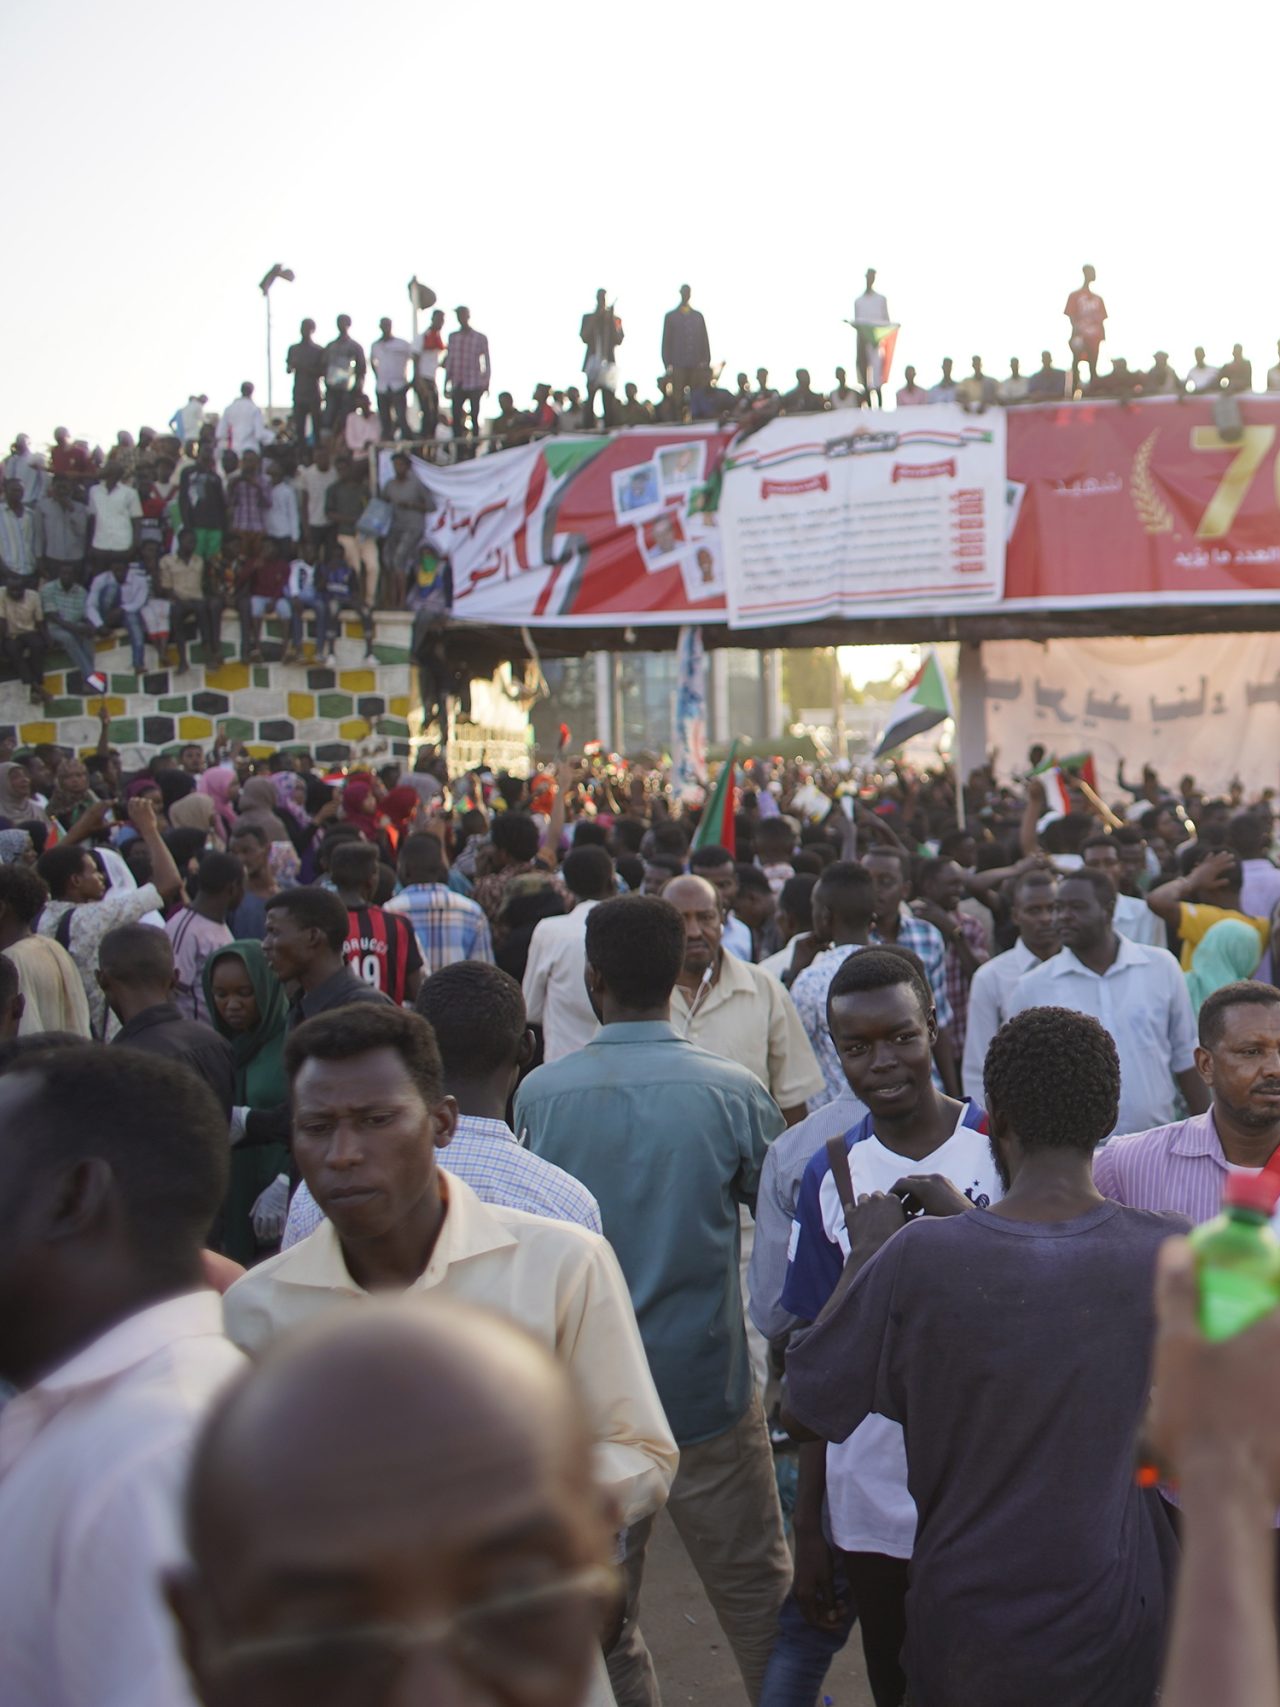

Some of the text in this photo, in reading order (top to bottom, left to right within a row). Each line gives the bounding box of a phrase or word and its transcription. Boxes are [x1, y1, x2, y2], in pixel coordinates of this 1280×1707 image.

[1053, 471, 1122, 498] شهيد
[1211, 547, 1232, 564] ما
[1234, 545, 1280, 563] العدد
[350, 954, 381, 990] 19
